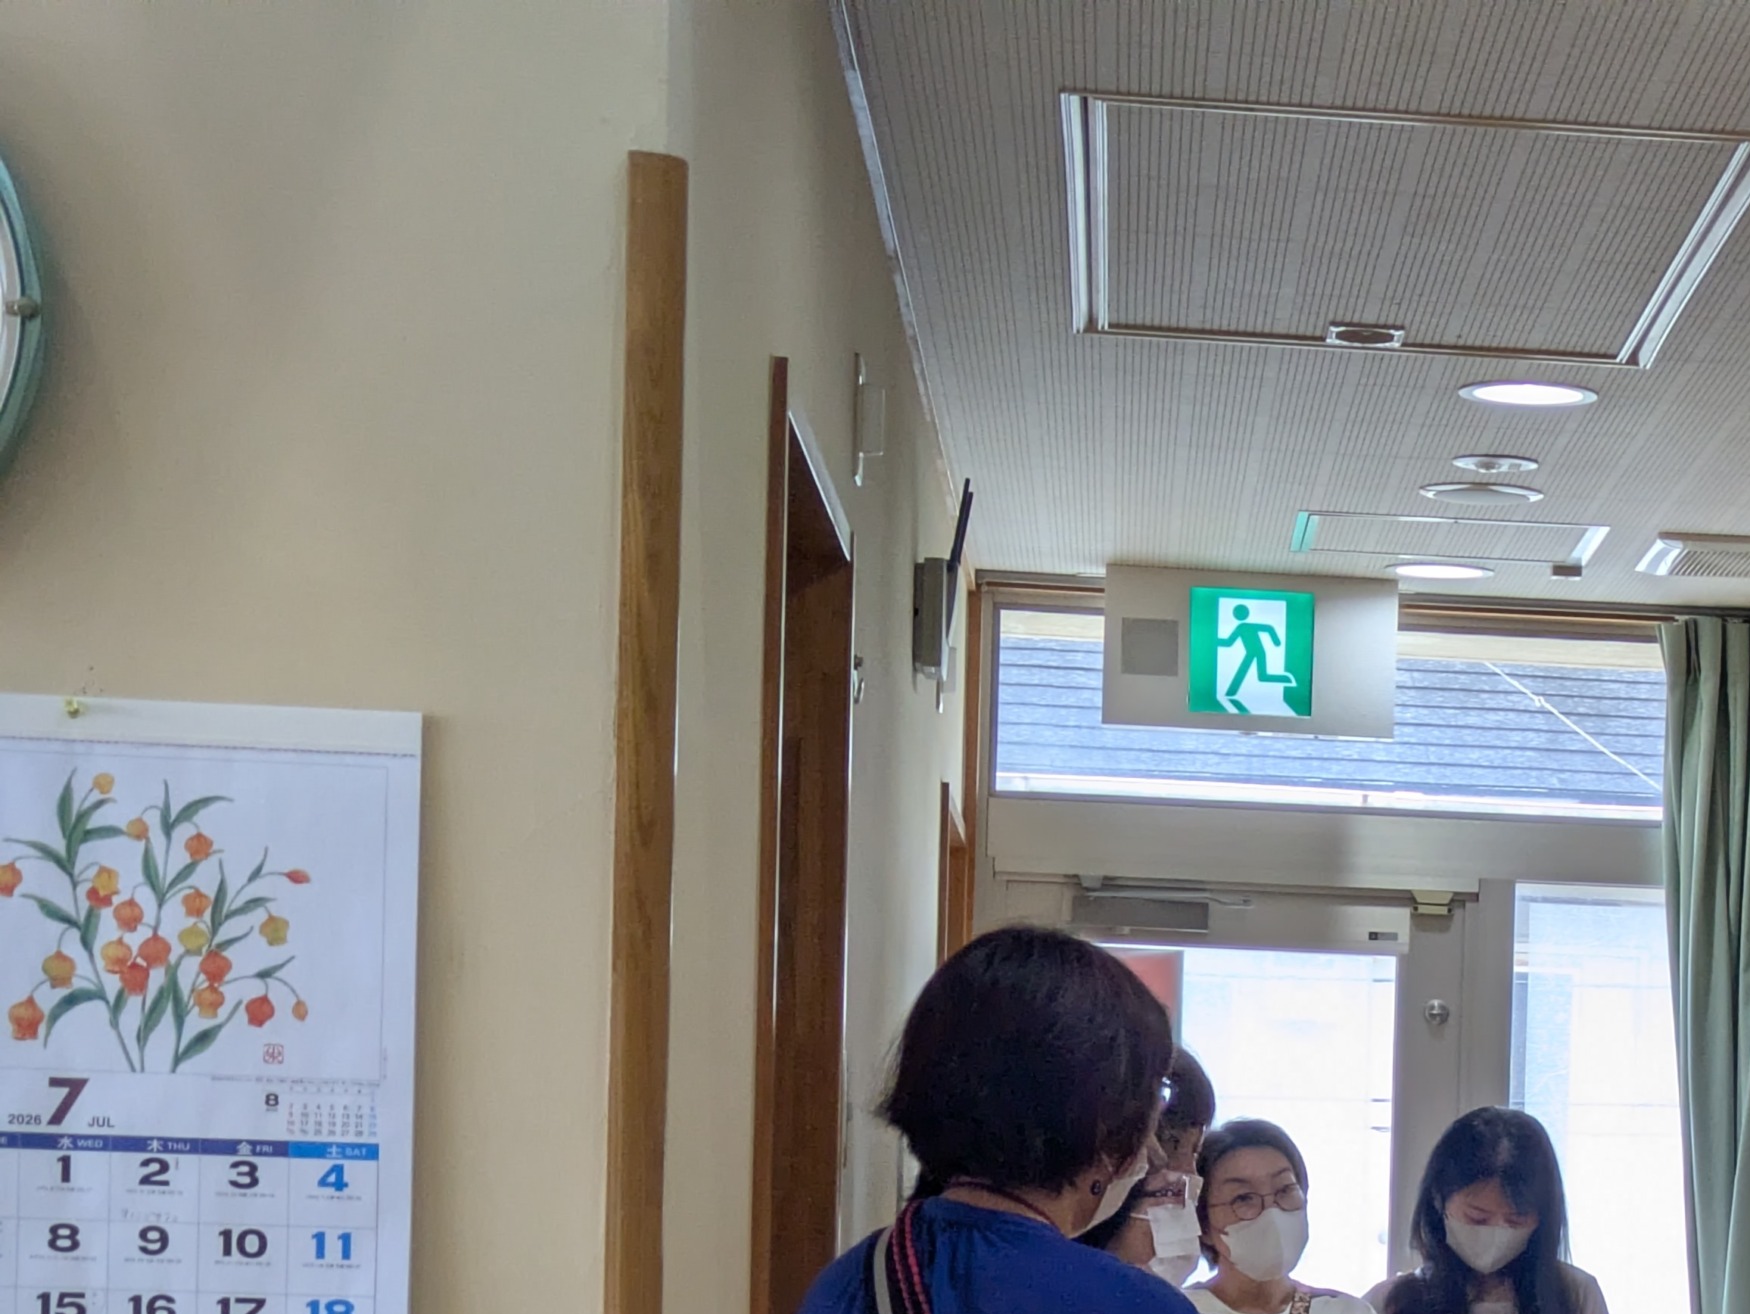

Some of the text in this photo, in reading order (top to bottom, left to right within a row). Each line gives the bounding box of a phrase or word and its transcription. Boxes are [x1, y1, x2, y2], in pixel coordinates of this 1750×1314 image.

[8, 1077, 115, 1128] 2026 7 JUL
[265, 1093, 279, 1107] 8
[57, 1135, 367, 1158] 水 WED 木 THU 金 FRI 土 SAT
[56, 1154, 349, 1192] 1 2 3 4
[47, 1223, 352, 1261] 8 9 10 11
